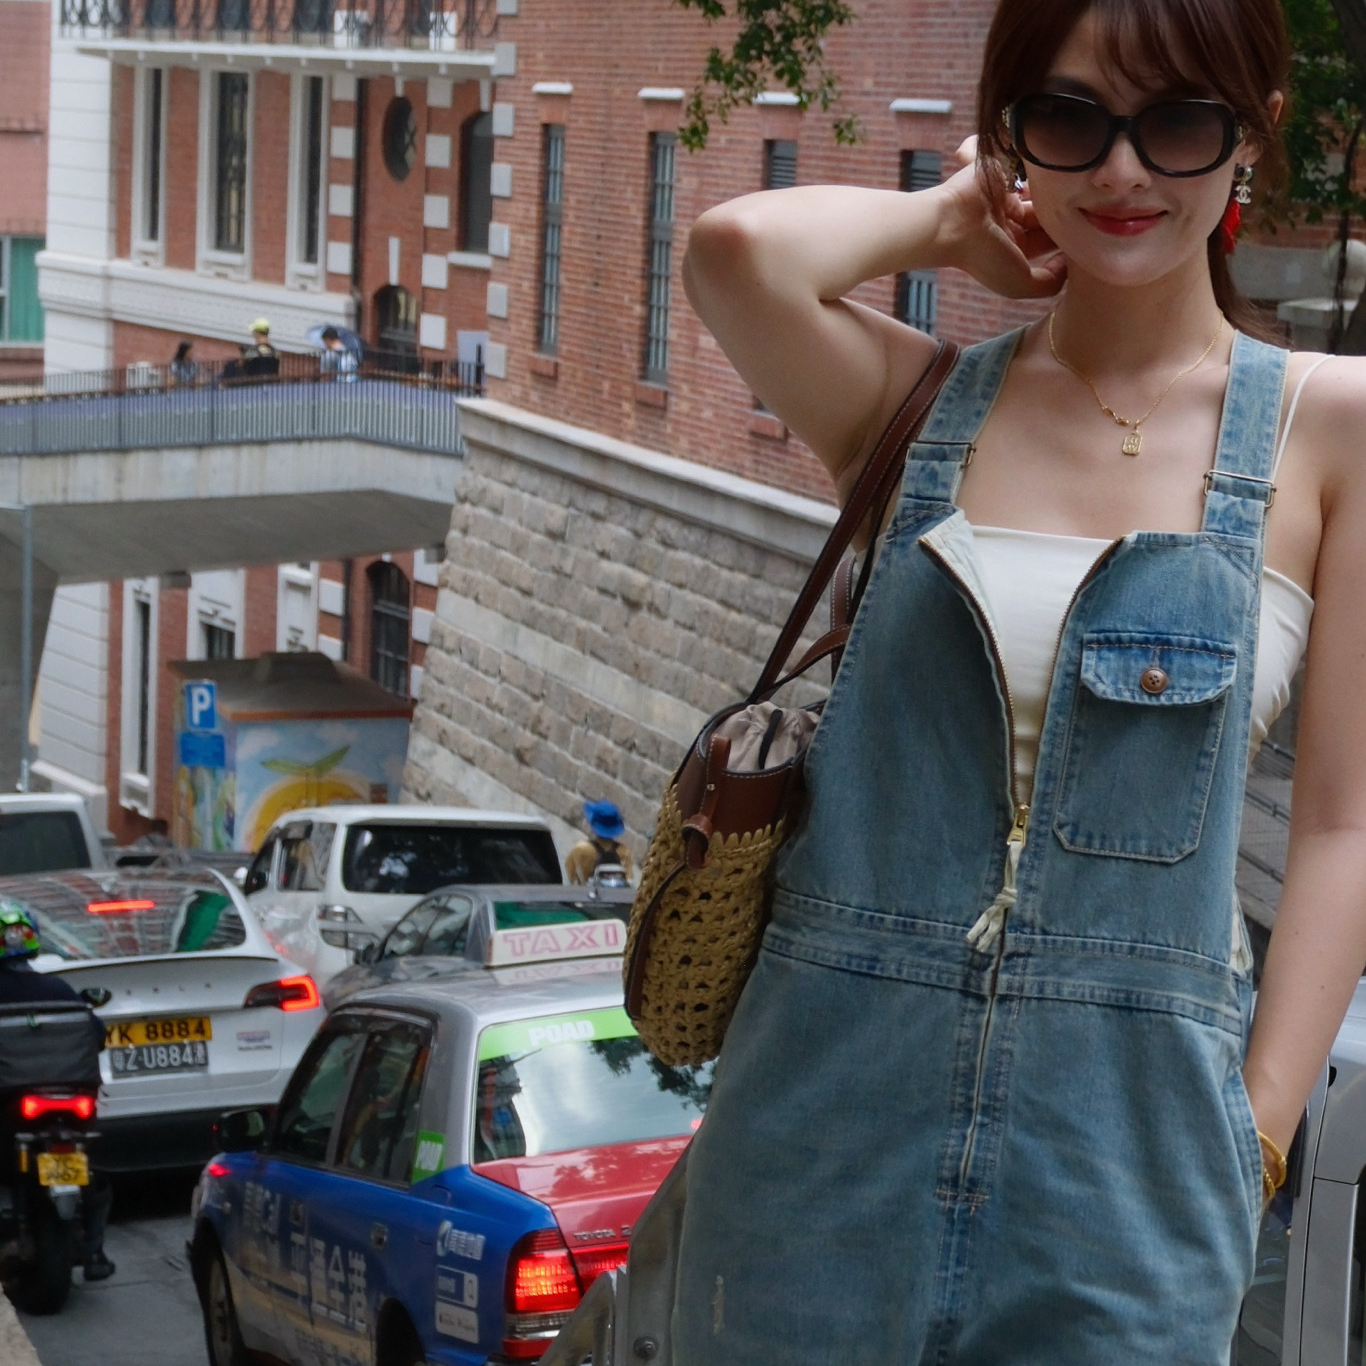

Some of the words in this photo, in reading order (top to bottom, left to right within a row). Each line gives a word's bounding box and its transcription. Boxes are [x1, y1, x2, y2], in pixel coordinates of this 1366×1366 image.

[192, 686, 211, 726] P
[502, 923, 619, 957] TAXI
[145, 1017, 206, 1041] 8884
